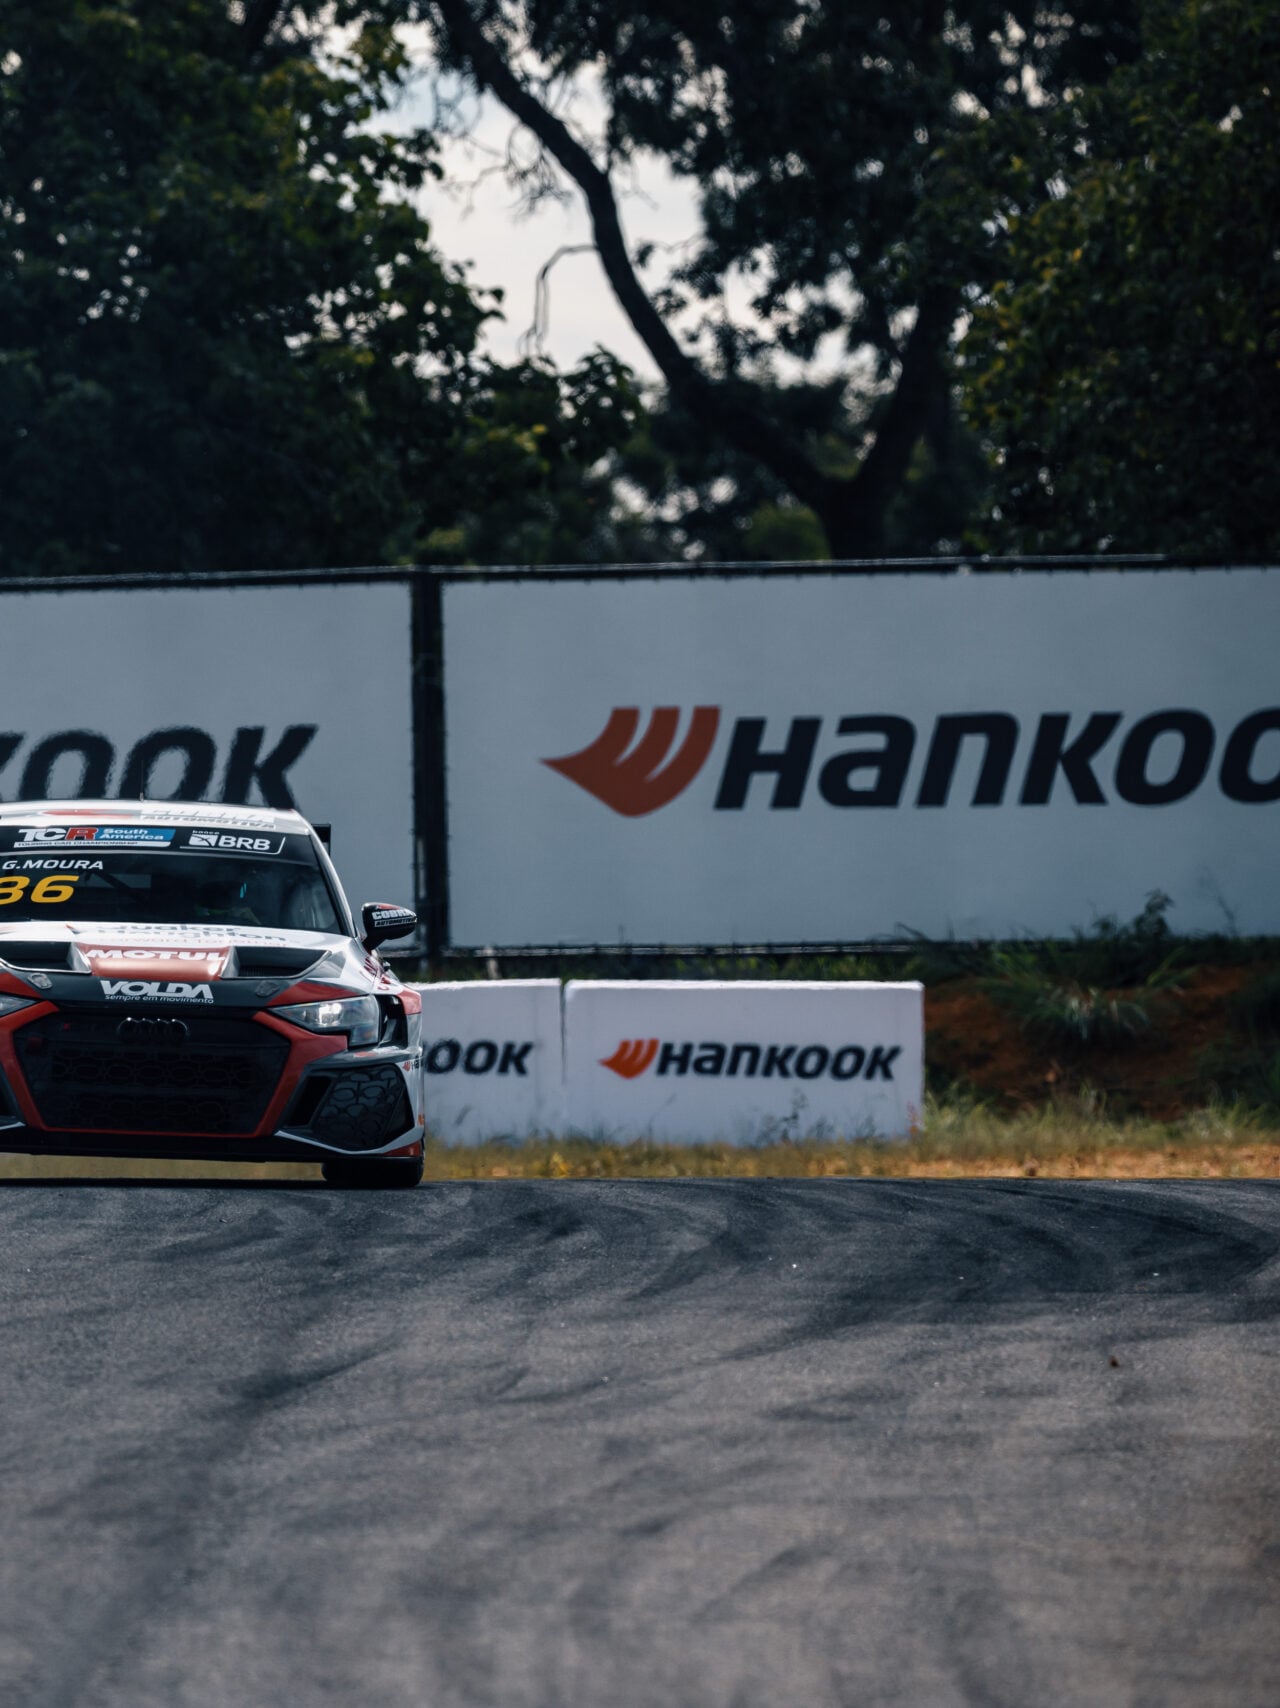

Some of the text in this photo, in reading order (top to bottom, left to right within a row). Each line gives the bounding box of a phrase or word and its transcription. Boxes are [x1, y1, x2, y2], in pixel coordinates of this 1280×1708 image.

[18, 827, 100, 842] TCR
[99, 832, 165, 841] America
[103, 828, 149, 836] South
[217, 834, 271, 851] BRB
[2, 859, 104, 870] G.MOURA
[86, 949, 228, 961] MOTUL
[100, 980, 214, 999] VOLDA
[655, 1041, 903, 1081] HANKOOK
